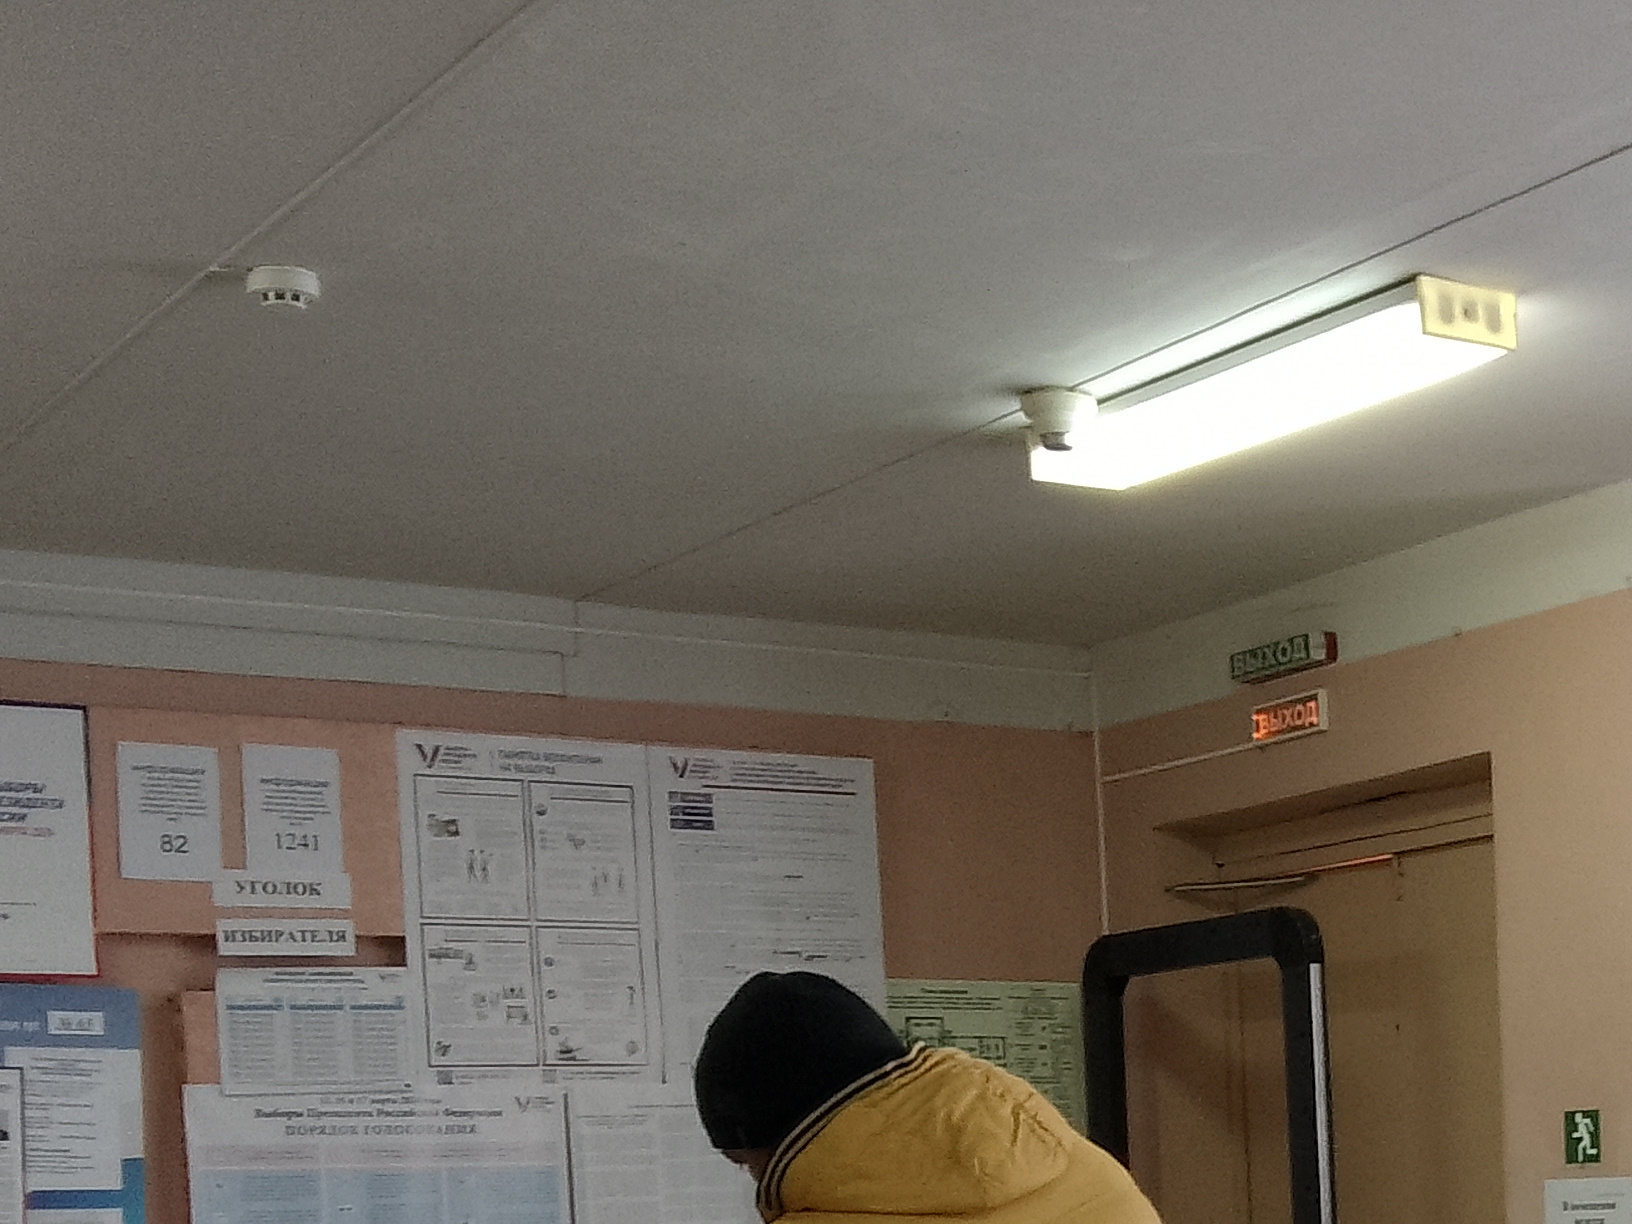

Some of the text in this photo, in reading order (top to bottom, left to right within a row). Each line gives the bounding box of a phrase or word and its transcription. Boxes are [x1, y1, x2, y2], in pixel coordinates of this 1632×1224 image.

[1232, 635, 1308, 676] ВЫХОД
[1258, 699, 1319, 736] ВЫХОД
[159, 834, 190, 854] 82
[274, 832, 320, 852] 1241
[235, 880, 323, 897] УГОЛОК
[222, 929, 348, 944] ИЗБИРАТЕЛЯ
